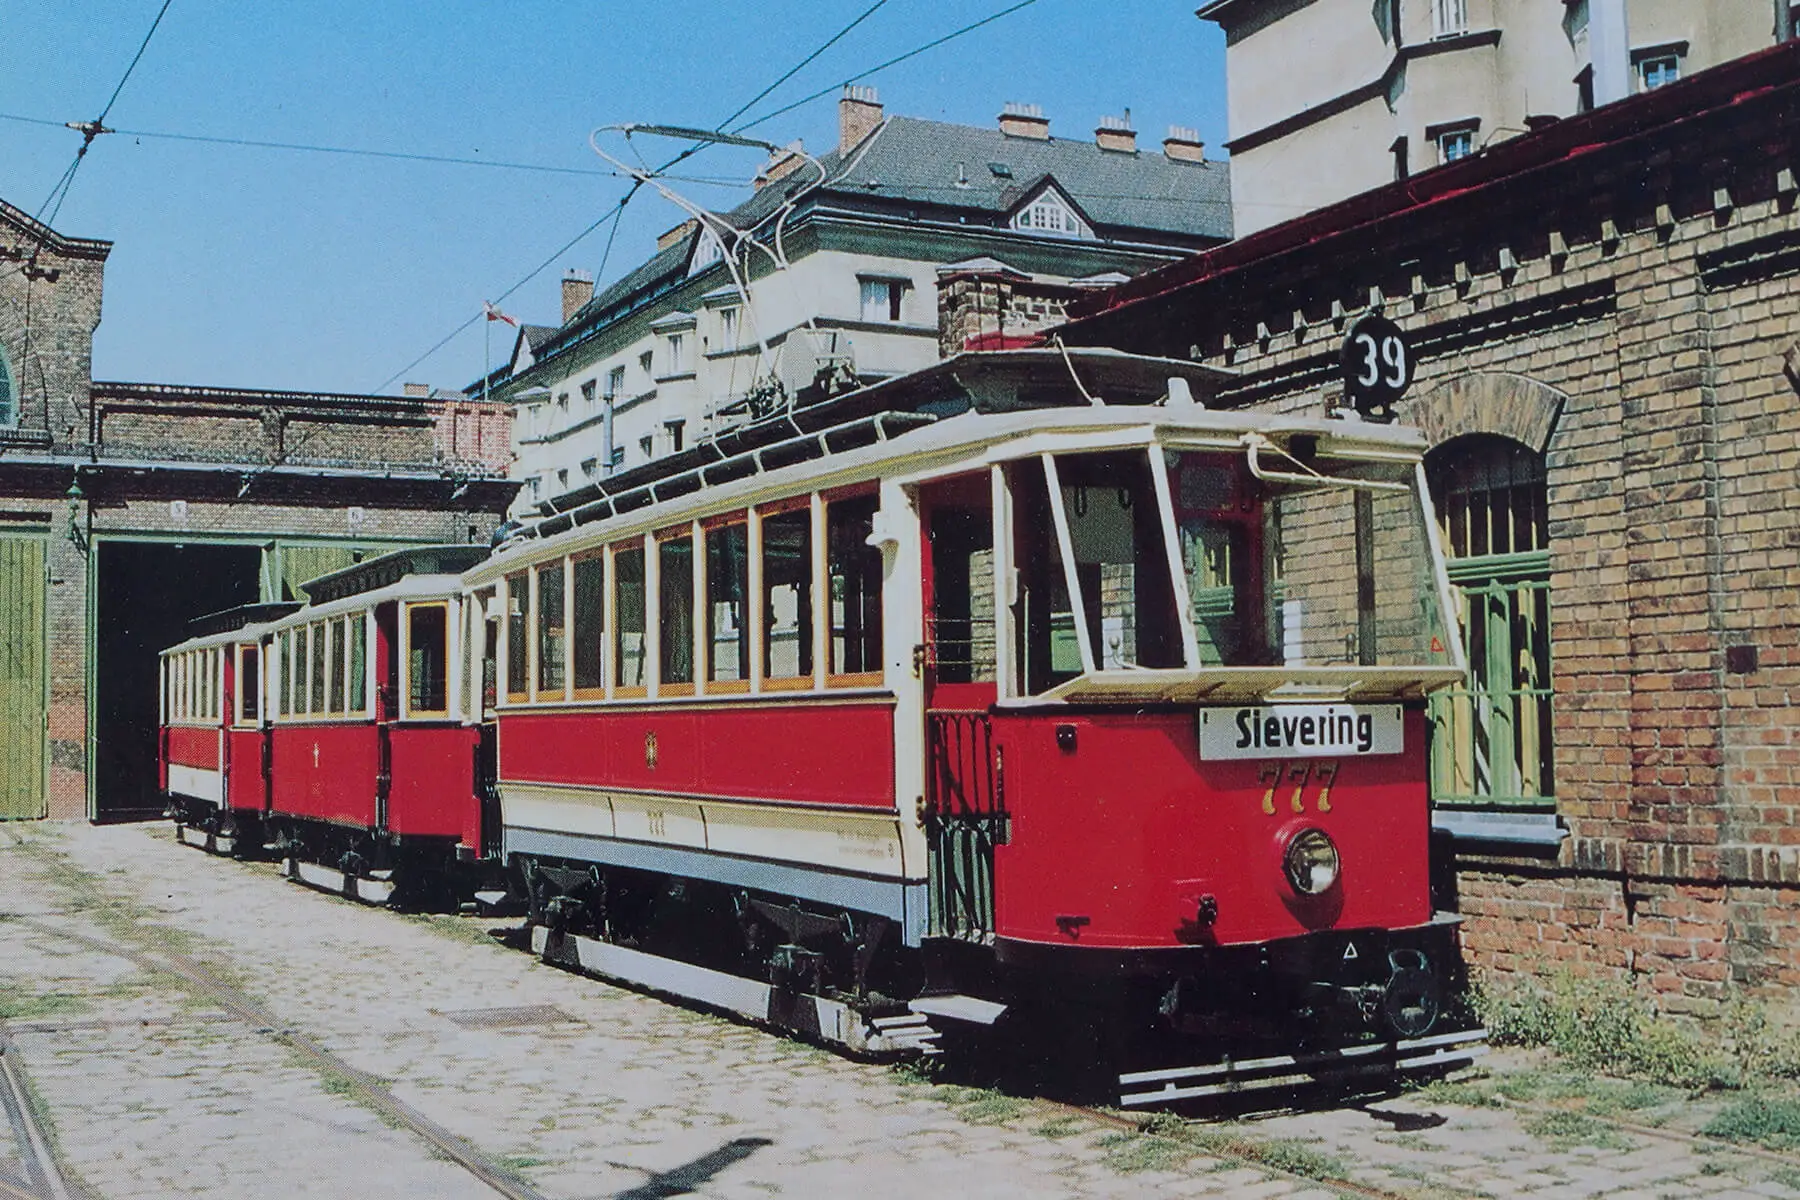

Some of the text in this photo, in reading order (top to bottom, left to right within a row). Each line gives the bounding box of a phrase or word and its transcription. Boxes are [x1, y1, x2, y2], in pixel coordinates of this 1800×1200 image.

[1355, 333, 1406, 388] 39
[1235, 707, 1373, 752] Sievering
[1259, 758, 1340, 816] 777
